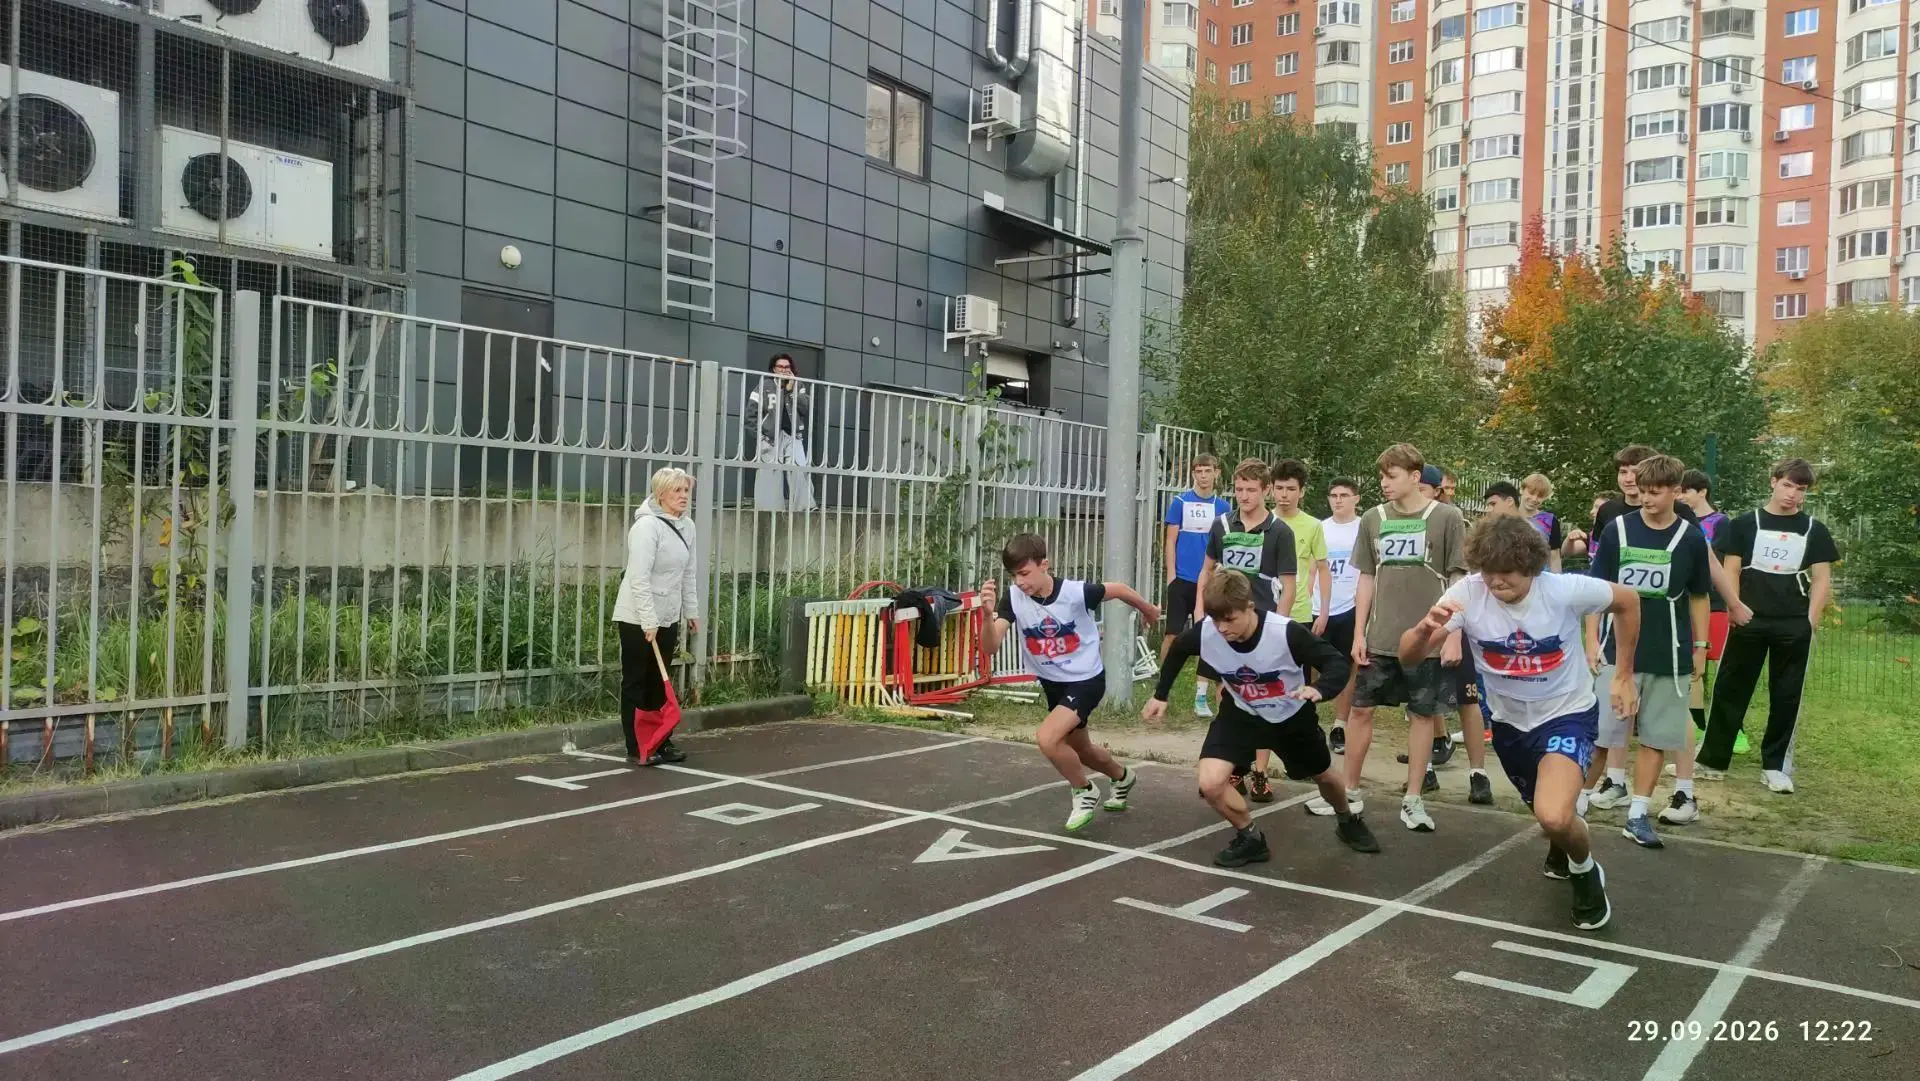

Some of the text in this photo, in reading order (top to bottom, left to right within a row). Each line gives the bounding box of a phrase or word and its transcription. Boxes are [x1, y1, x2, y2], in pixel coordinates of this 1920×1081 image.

[1190, 509, 1207, 519] 161
[1384, 539, 1418, 556] 271
[1762, 546, 1789, 561] 162
[1227, 549, 1256, 568] 272
[1623, 567, 1664, 588] 270
[1036, 638, 1067, 658] 728
[1500, 655, 1543, 672] 701
[1234, 682, 1269, 698] 705
[1465, 683, 1478, 697] 39
[1545, 735, 1577, 754] 99
